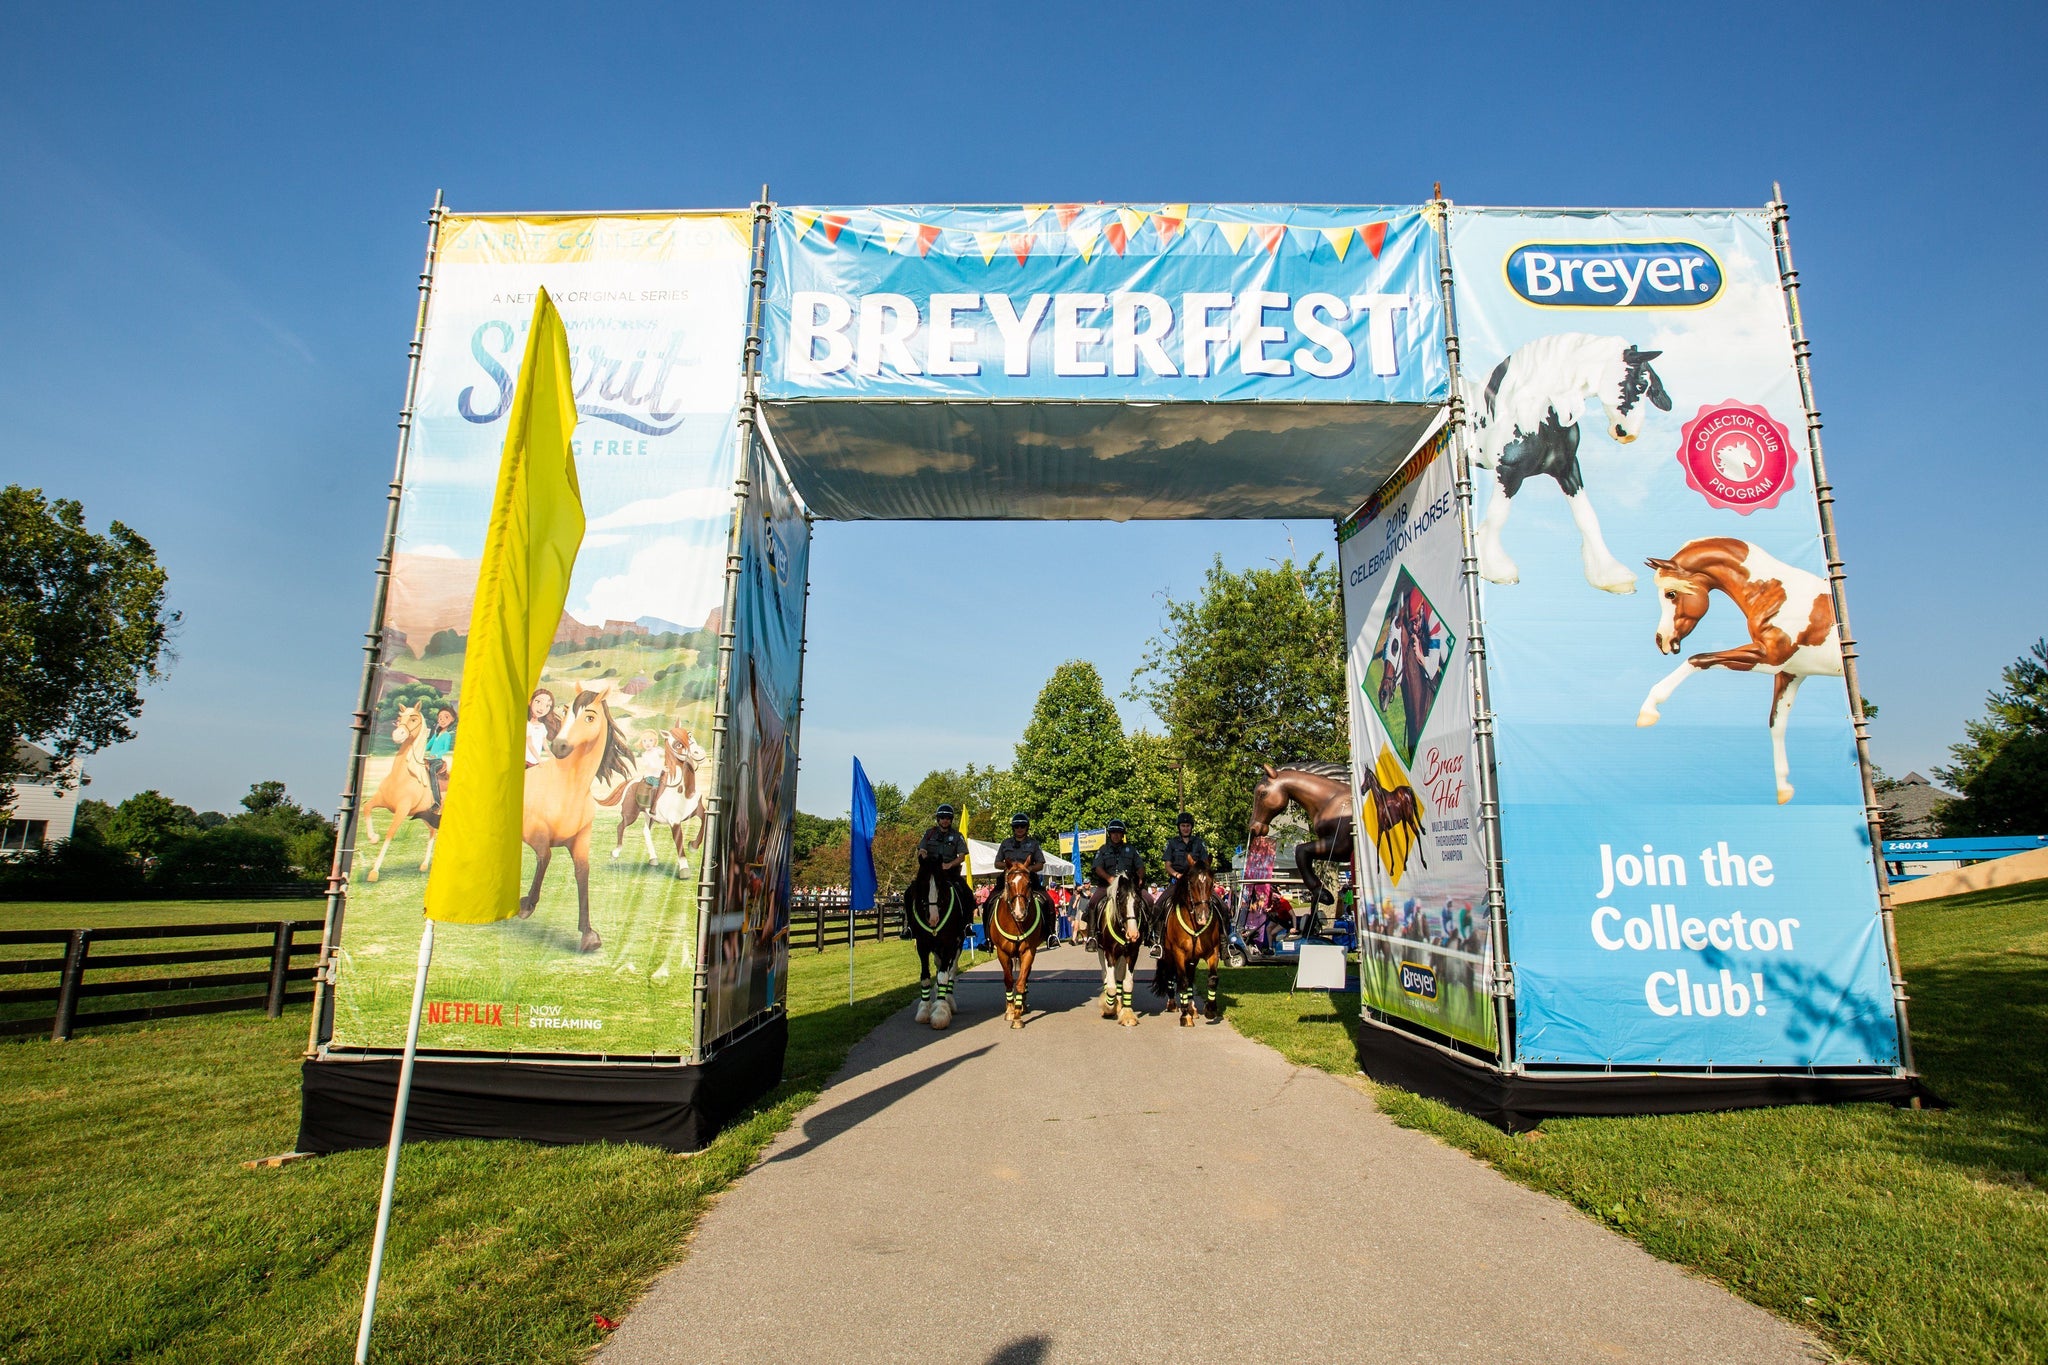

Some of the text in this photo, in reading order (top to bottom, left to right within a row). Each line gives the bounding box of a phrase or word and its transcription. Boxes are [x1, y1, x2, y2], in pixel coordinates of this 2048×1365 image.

[456, 229, 736, 251] SPIRIT COLLECTION
[1523, 251, 1704, 306] Breyer
[490, 289, 690, 303] A NETIX ORIGINAL SERIES
[788, 291, 1412, 378] BREYERFEST
[457, 319, 702, 424] Srit
[593, 439, 649, 456] FREE
[1695, 415, 1779, 453] COLLECTOR CLUB
[1708, 477, 1774, 500] PROGRAM
[1386, 502, 1408, 540] 2018
[1350, 491, 1450, 587] CELEBRATION HORSE
[1423, 746, 1464, 786] Brass
[1431, 778, 1467, 816] Hat
[1435, 834, 1468, 846] THOROUGHBRED
[1441, 850, 1463, 861] CHAMPION
[1889, 841, 1929, 850] Z-60/34
[1595, 841, 1775, 899] Join the
[1591, 903, 1801, 951] Collector
[1403, 967, 1434, 995] Breyer
[1644, 969, 1767, 1017] Club!
[428, 1001, 503, 1027] NETFLIX
[529, 1017, 602, 1030] STREAMING
[530, 1005, 562, 1016] NOW
